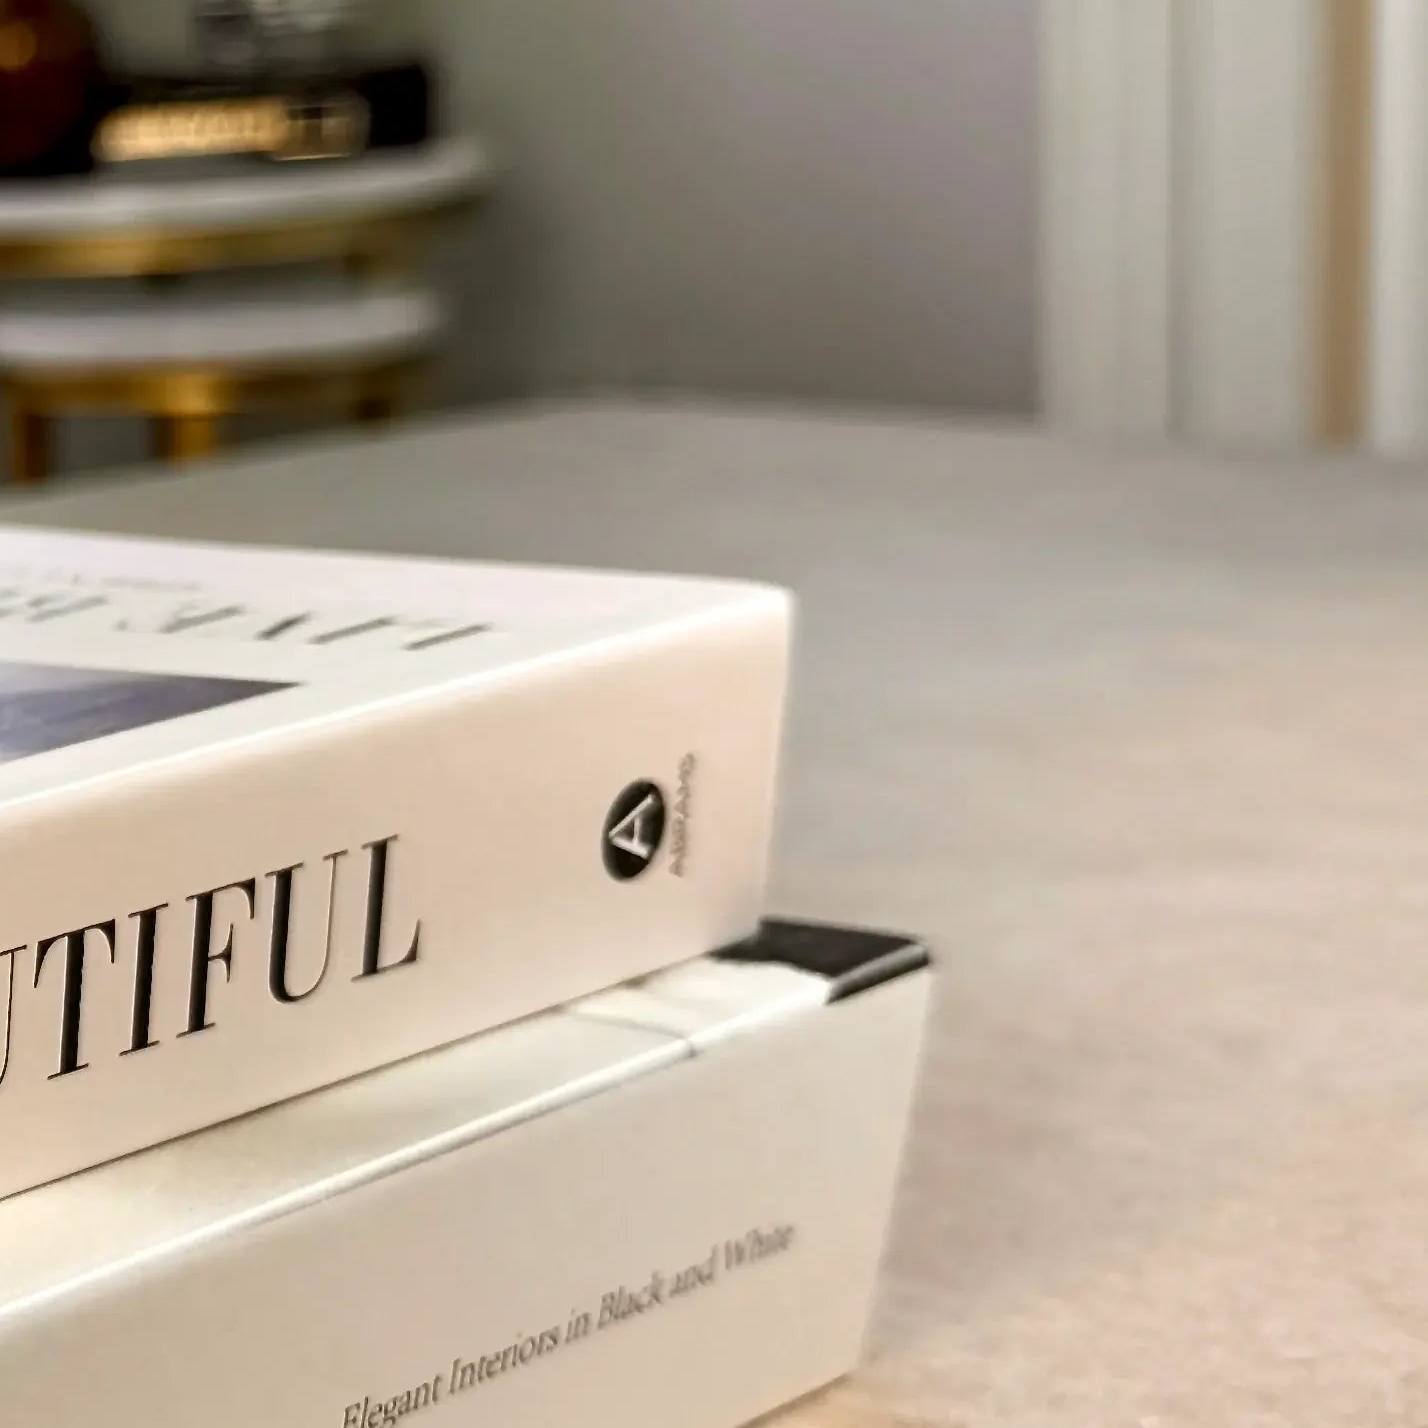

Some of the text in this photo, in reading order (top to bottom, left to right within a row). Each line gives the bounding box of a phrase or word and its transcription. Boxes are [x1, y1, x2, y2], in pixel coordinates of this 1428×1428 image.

[447, 1329, 561, 1396] Interiors
[564, 1307, 593, 1343] in
[596, 1269, 665, 1330] Black
[667, 1243, 719, 1298] and
[722, 1222, 798, 1271] White
